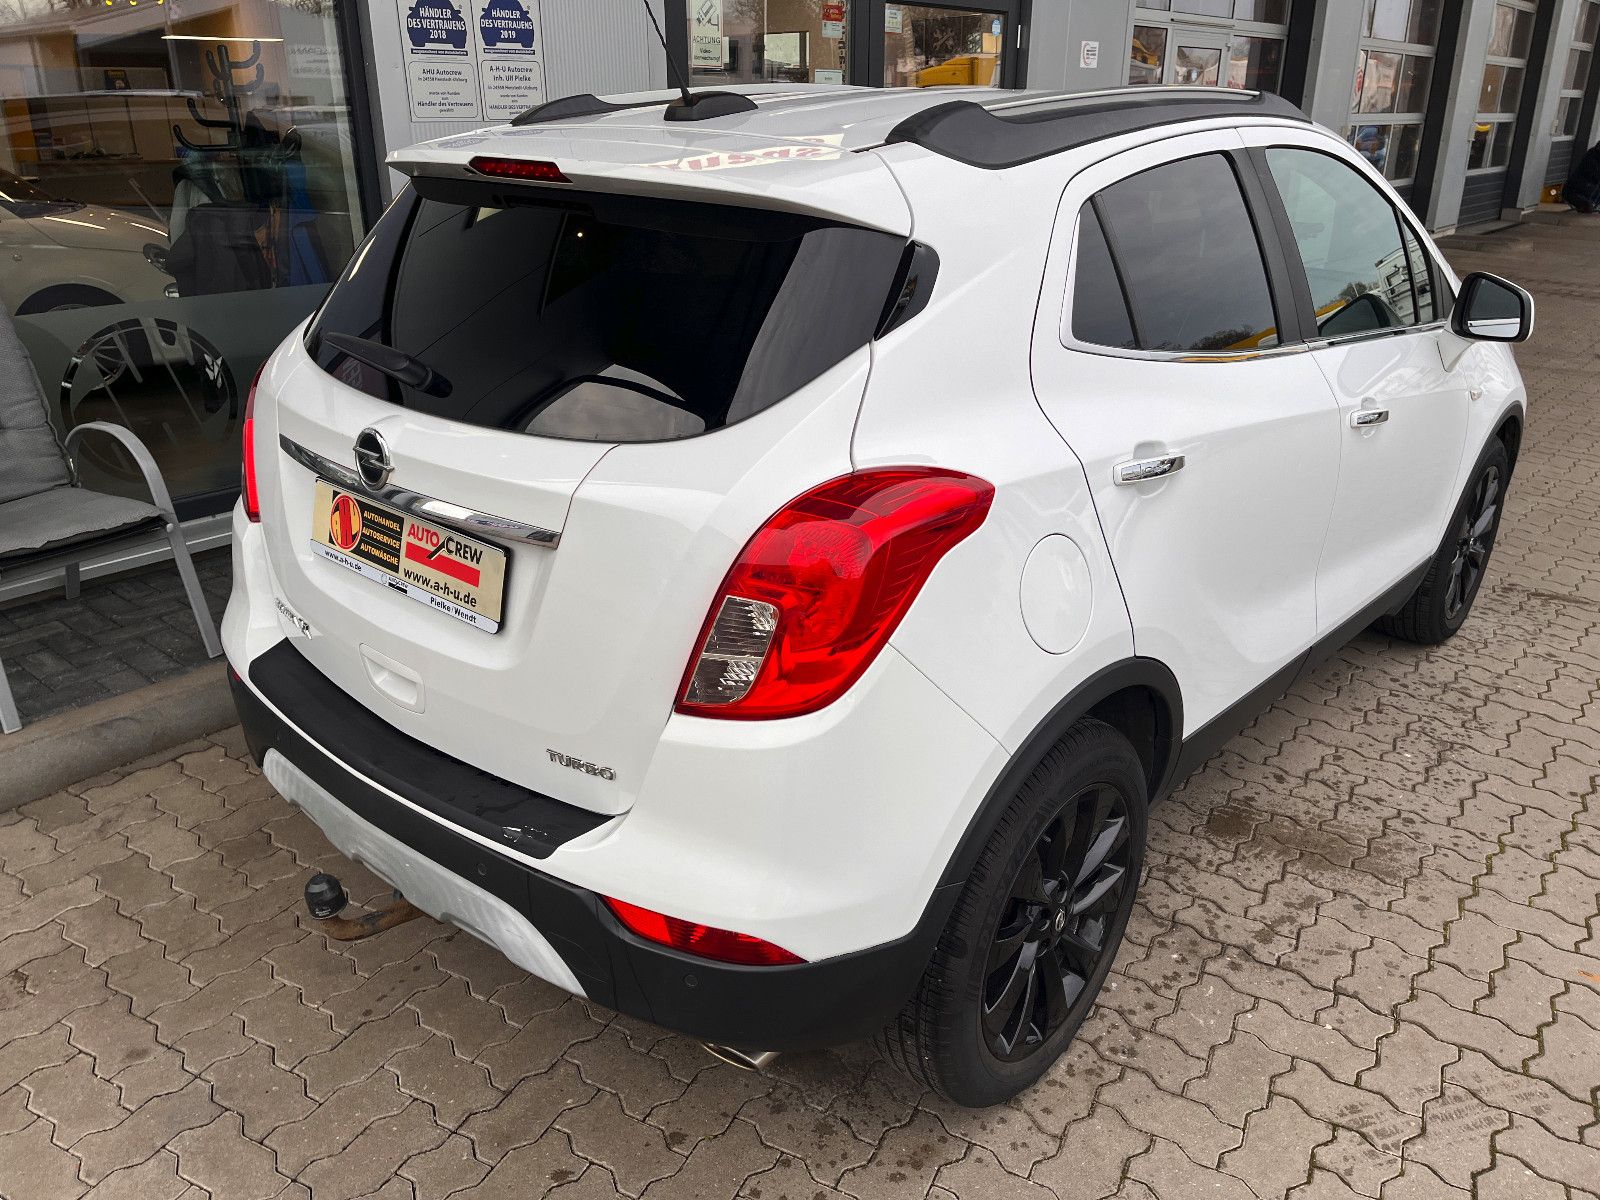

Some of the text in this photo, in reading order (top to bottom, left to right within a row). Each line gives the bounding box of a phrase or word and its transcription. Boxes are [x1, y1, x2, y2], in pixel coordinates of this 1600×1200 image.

[420, 6, 452, 18] HÄNDLER
[492, 8, 521, 18] HÄNDLER
[408, 18, 465, 30] DES VERTRAUENS
[481, 19, 533, 30] DES VERTRAUENS
[430, 30, 447, 39] 2018
[500, 30, 516, 39] 2019
[693, 36, 721, 44] ACHTUNG
[364, 510, 401, 531] AUTOHANDEL
[362, 527, 401, 548] AUTOSERVICE
[407, 523, 483, 565] AUTO CREW
[325, 550, 362, 571] www.a-h-u.de
[360, 543, 399, 565] AUTOWÄSCHE
[403, 568, 477, 608] www.a-h-u.de
[546, 748, 617, 781] TURBO
